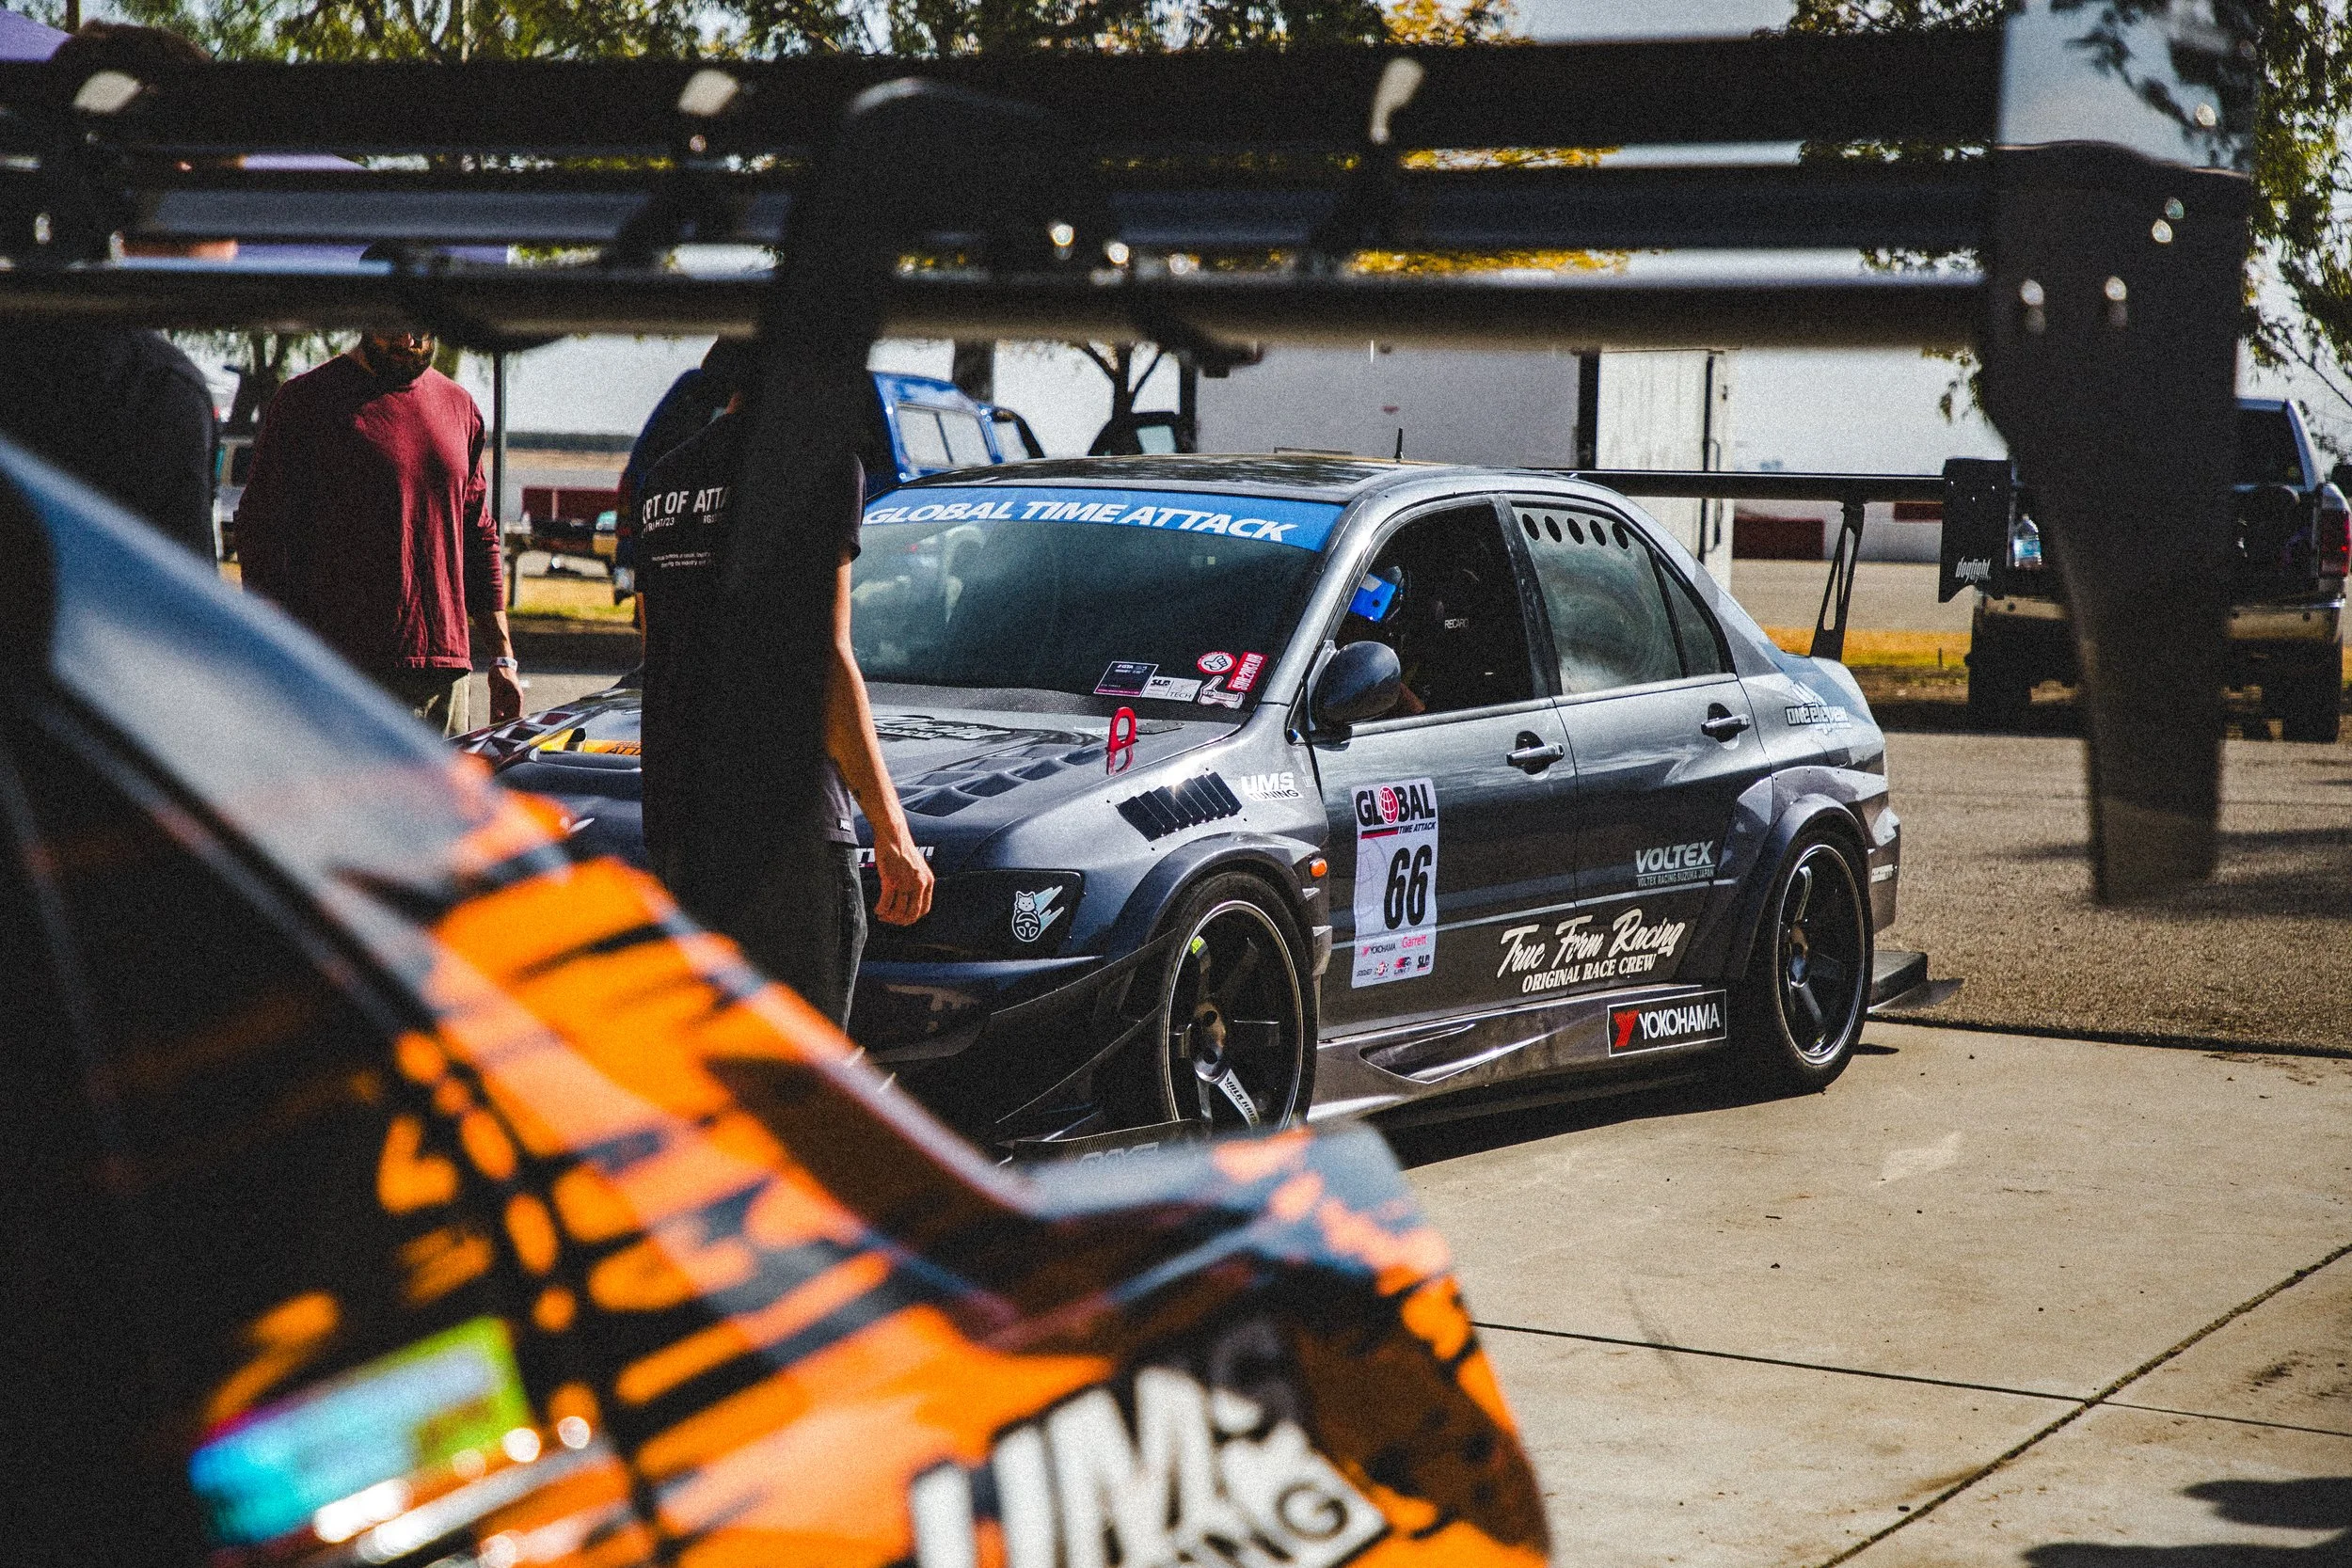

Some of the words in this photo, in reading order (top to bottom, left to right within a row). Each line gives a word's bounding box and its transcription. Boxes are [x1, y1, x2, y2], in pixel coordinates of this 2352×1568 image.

[664, 491, 690, 515] OF
[692, 486, 728, 513] ATT
[864, 501, 1013, 525] GLOBAL
[1025, 500, 1131, 523] TIME
[1117, 505, 1298, 542] ATTACK
[605, 745, 641, 756] ATT
[1241, 771, 1295, 791] UMS
[1355, 784, 1436, 827] GLOBAL
[1413, 821, 1437, 833] ATTACK
[1635, 840, 1714, 874] VOLTEX
[1383, 844, 1433, 930] 66
[1402, 934, 1427, 948] Garrett
[1497, 924, 1548, 978] True
[1607, 908, 1686, 958] Racing
[1522, 966, 1581, 993] ORIGINAL
[1582, 957, 1615, 980] RACE
[1618, 954, 1658, 974] CREW
[1638, 1003, 1721, 1040] YOKOHAMA
